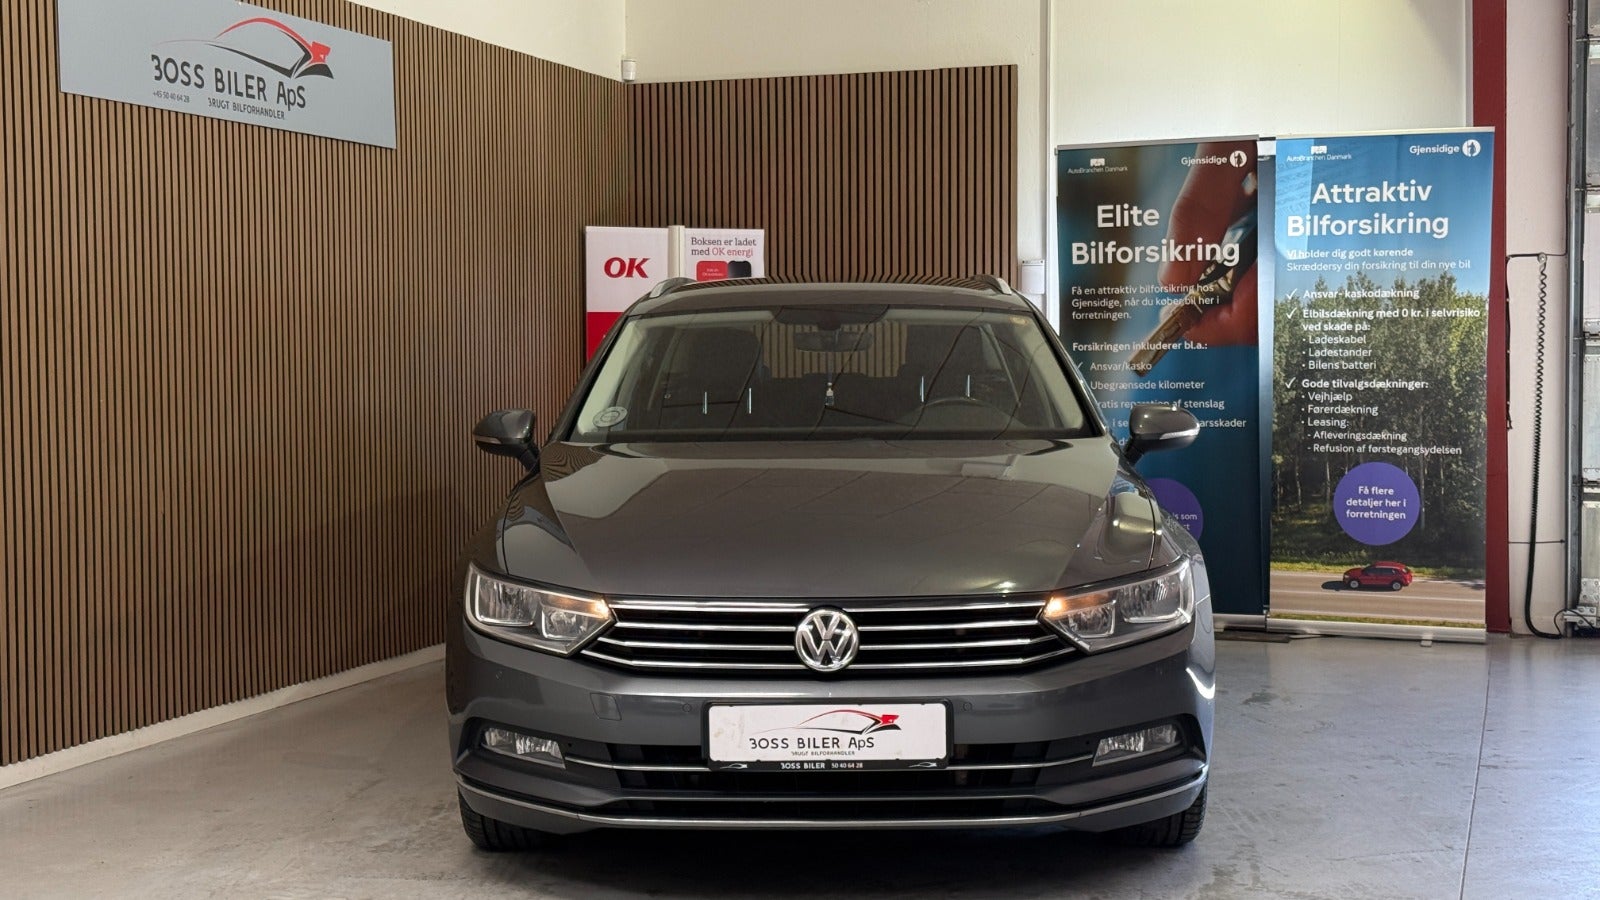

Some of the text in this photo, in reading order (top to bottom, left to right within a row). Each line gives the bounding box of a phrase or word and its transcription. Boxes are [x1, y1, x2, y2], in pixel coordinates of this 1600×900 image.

[214, 67, 268, 101] BILER
[276, 81, 307, 111] ApS
[232, 102, 285, 120] BILFORHANDLER
[1409, 144, 1460, 155] Gjensidige
[1181, 156, 1228, 166] Gjensidige
[1286, 154, 1326, 162] AutoBranchen
[1312, 179, 1433, 204] Attraktiv
[1096, 204, 1160, 228] Elite
[1287, 212, 1449, 239] Bilforsikring
[691, 236, 722, 246] Boksen
[734, 237, 757, 246] ladet
[691, 247, 754, 258] med OK energi
[1072, 237, 1240, 267] Bilforsikring
[1287, 248, 1414, 260] Vi holder dig godt kørende
[604, 256, 651, 279] OK
[1287, 259, 1471, 273] Skræddersy din forsikring til din nye bil
[1072, 286, 1082, 296] Få
[1097, 286, 1137, 295] attraktiv
[1139, 284, 1195, 296] bilforsikring
[1197, 284, 1214, 293] hos
[1303, 288, 1420, 300] Ansvar- kaskodækning
[1072, 296, 1220, 309] Gjensidige, når du køber bil her i
[1072, 310, 1132, 320] forretningen.
[1303, 308, 1480, 320] Elbilsdækning med 0 kr. i selvrisiko
[1303, 320, 1370, 333] ved skade på:
[1309, 335, 1367, 344] Ladeskabel
[1072, 341, 1208, 353] Forsikringen inkluderer bl.a.:
[1308, 348, 1372, 357] Ladestander
[1090, 362, 1152, 372] Ansvar/kasko
[1308, 361, 1377, 370] Bilens batteri
[1090, 380, 1205, 392] Ubegrænsede kilometer
[1301, 379, 1429, 390] Gode tilvalgsdækninger:
[1308, 392, 1353, 402] Vejhjælp
[1097, 400, 1119, 409] ratis
[1184, 399, 1225, 410] stenslag
[1308, 405, 1379, 416] Førerdækning
[1200, 418, 1246, 428] arsskader
[1307, 418, 1350, 429] Leasing:
[1313, 431, 1407, 442] Afleveringsdækning
[1313, 444, 1462, 455] Refusion af førstegangsydelsen
[1358, 485, 1394, 495] Få flere
[1346, 498, 1407, 508] detaljer her i
[1346, 509, 1406, 520] forretningen
[798, 737, 840, 748] BILER
[848, 737, 874, 750] ApS
